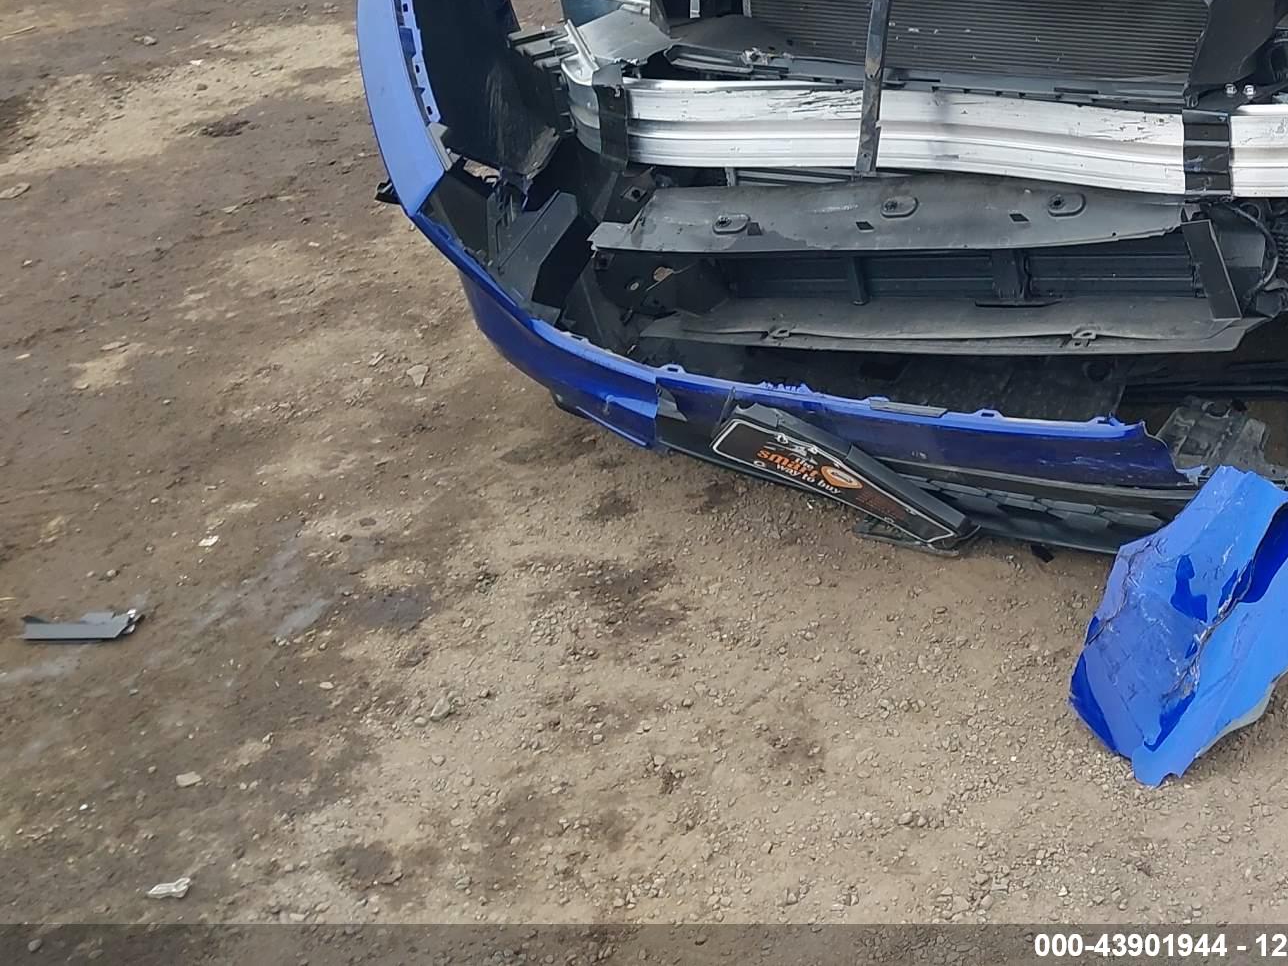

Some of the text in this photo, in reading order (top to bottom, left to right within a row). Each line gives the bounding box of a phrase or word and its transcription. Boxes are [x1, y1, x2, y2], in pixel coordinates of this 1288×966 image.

[756, 449, 819, 477] smart
[776, 463, 841, 494] way to buy
